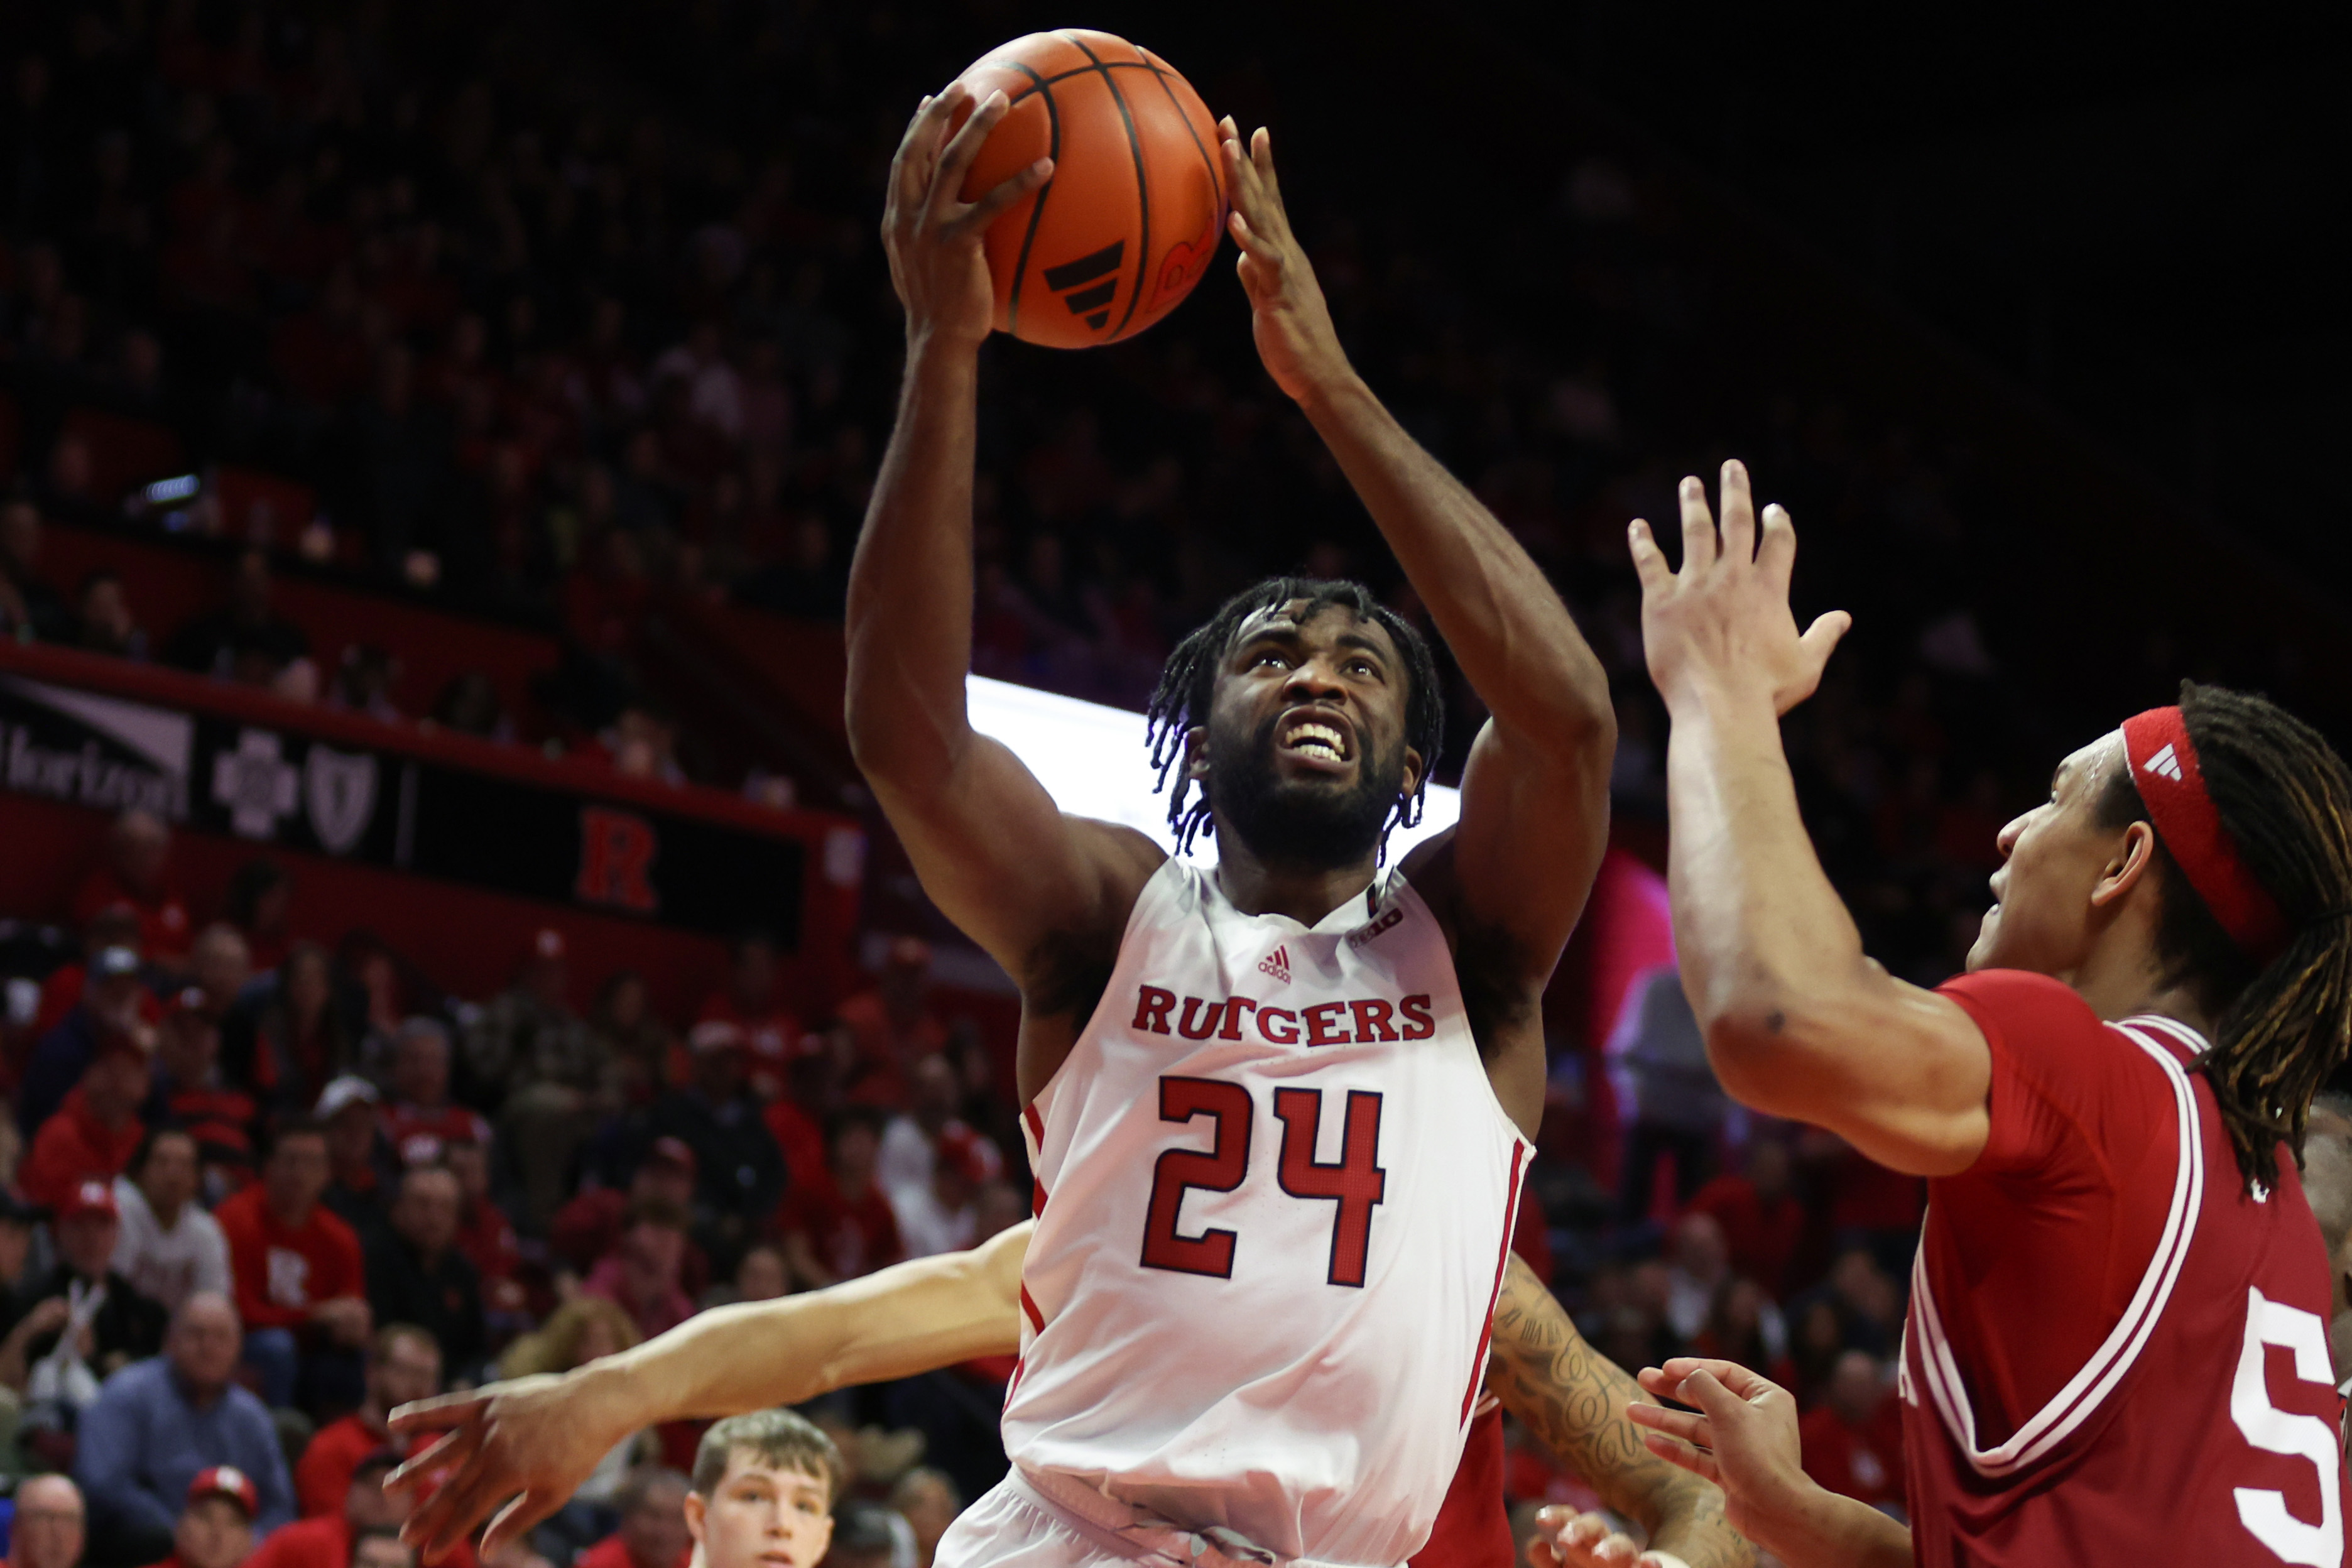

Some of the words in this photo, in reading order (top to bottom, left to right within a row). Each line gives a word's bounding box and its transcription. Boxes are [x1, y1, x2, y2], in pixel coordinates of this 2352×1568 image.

[573, 802, 662, 910] R
[1131, 984, 1435, 1048] RUTGERS
[1258, 961, 1291, 985] adidas
[1140, 1075, 1386, 1288] 24
[2230, 1284, 2345, 1568] 5
